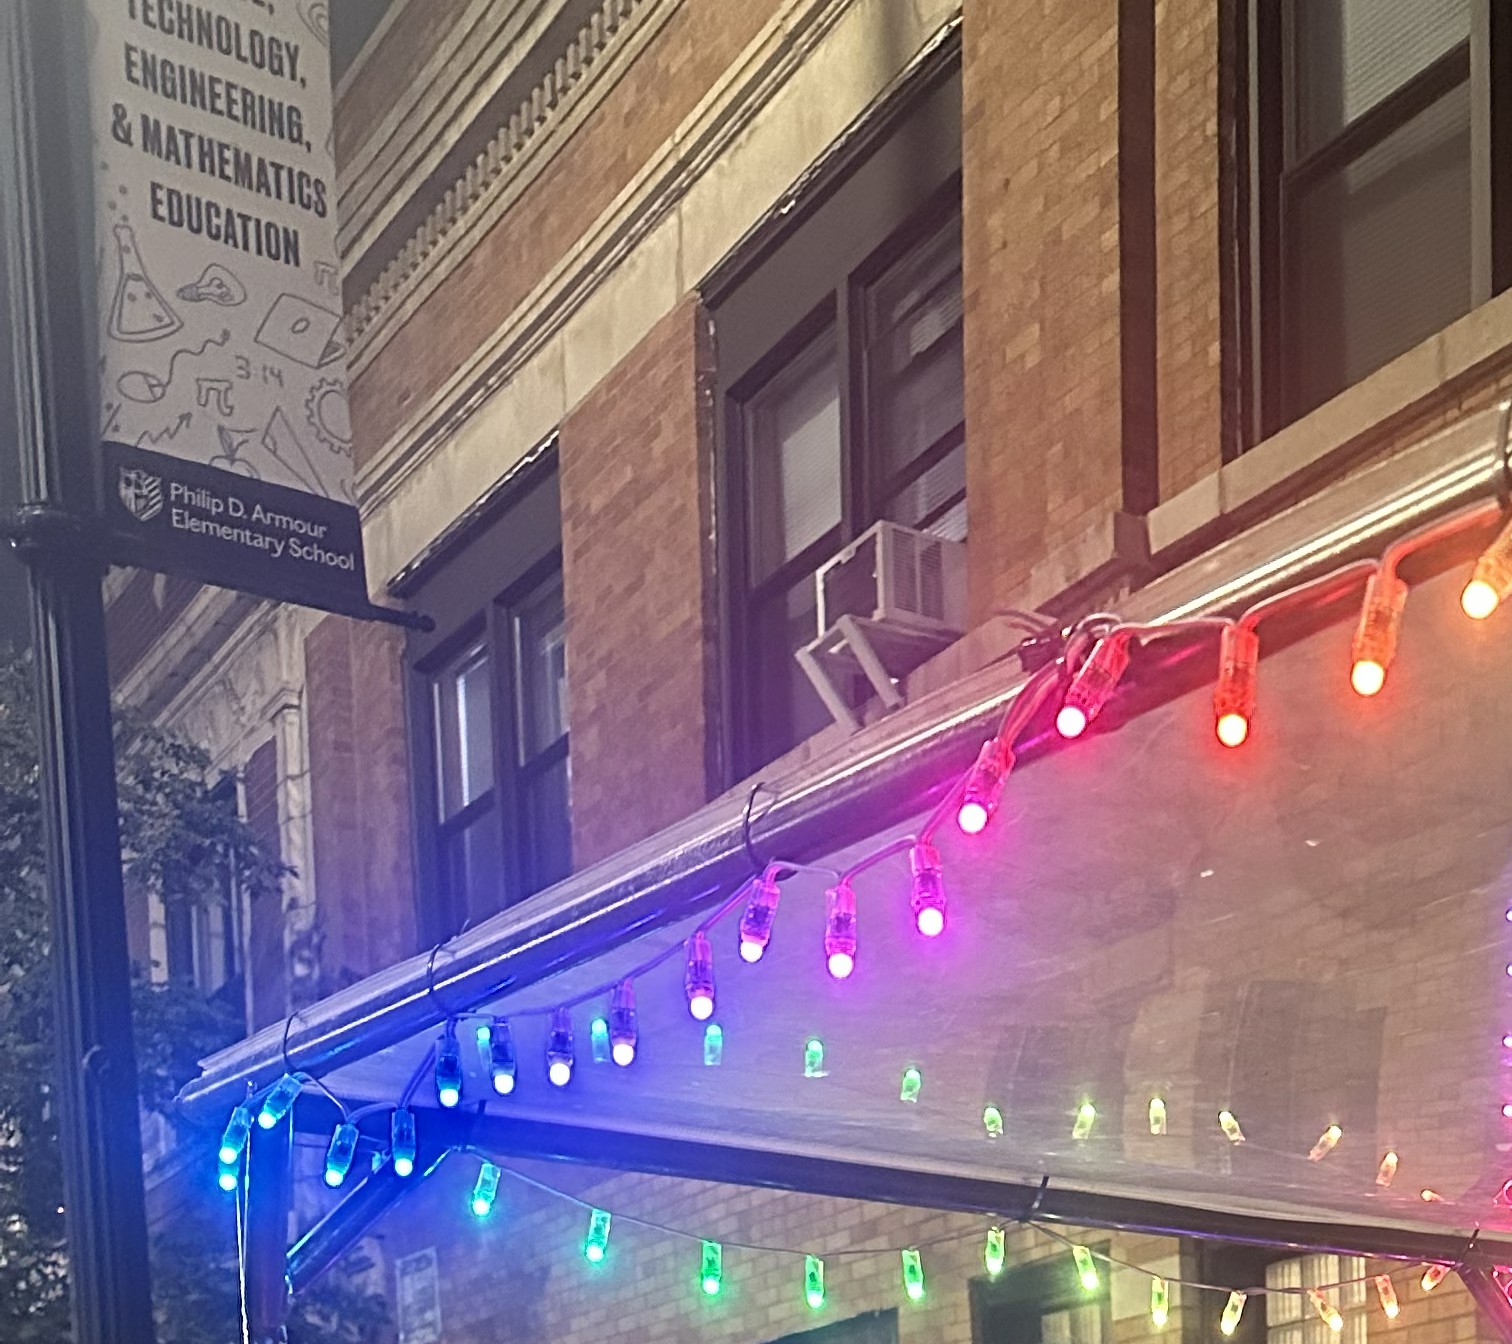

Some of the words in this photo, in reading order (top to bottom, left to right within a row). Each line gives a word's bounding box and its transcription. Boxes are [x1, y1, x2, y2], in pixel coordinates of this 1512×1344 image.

[128, 0, 307, 87] TECHNOLOGY,
[124, 44, 312, 153] ENGINEERING,
[111, 103, 133, 147] &
[141, 114, 328, 219] MATHEMATICS
[150, 181, 302, 268] EDUCATION
[170, 483, 224, 517] Philip
[228, 498, 249, 520] D.
[252, 504, 328, 540] Armour
[172, 510, 284, 558] Elementary
[288, 538, 356, 572] School
